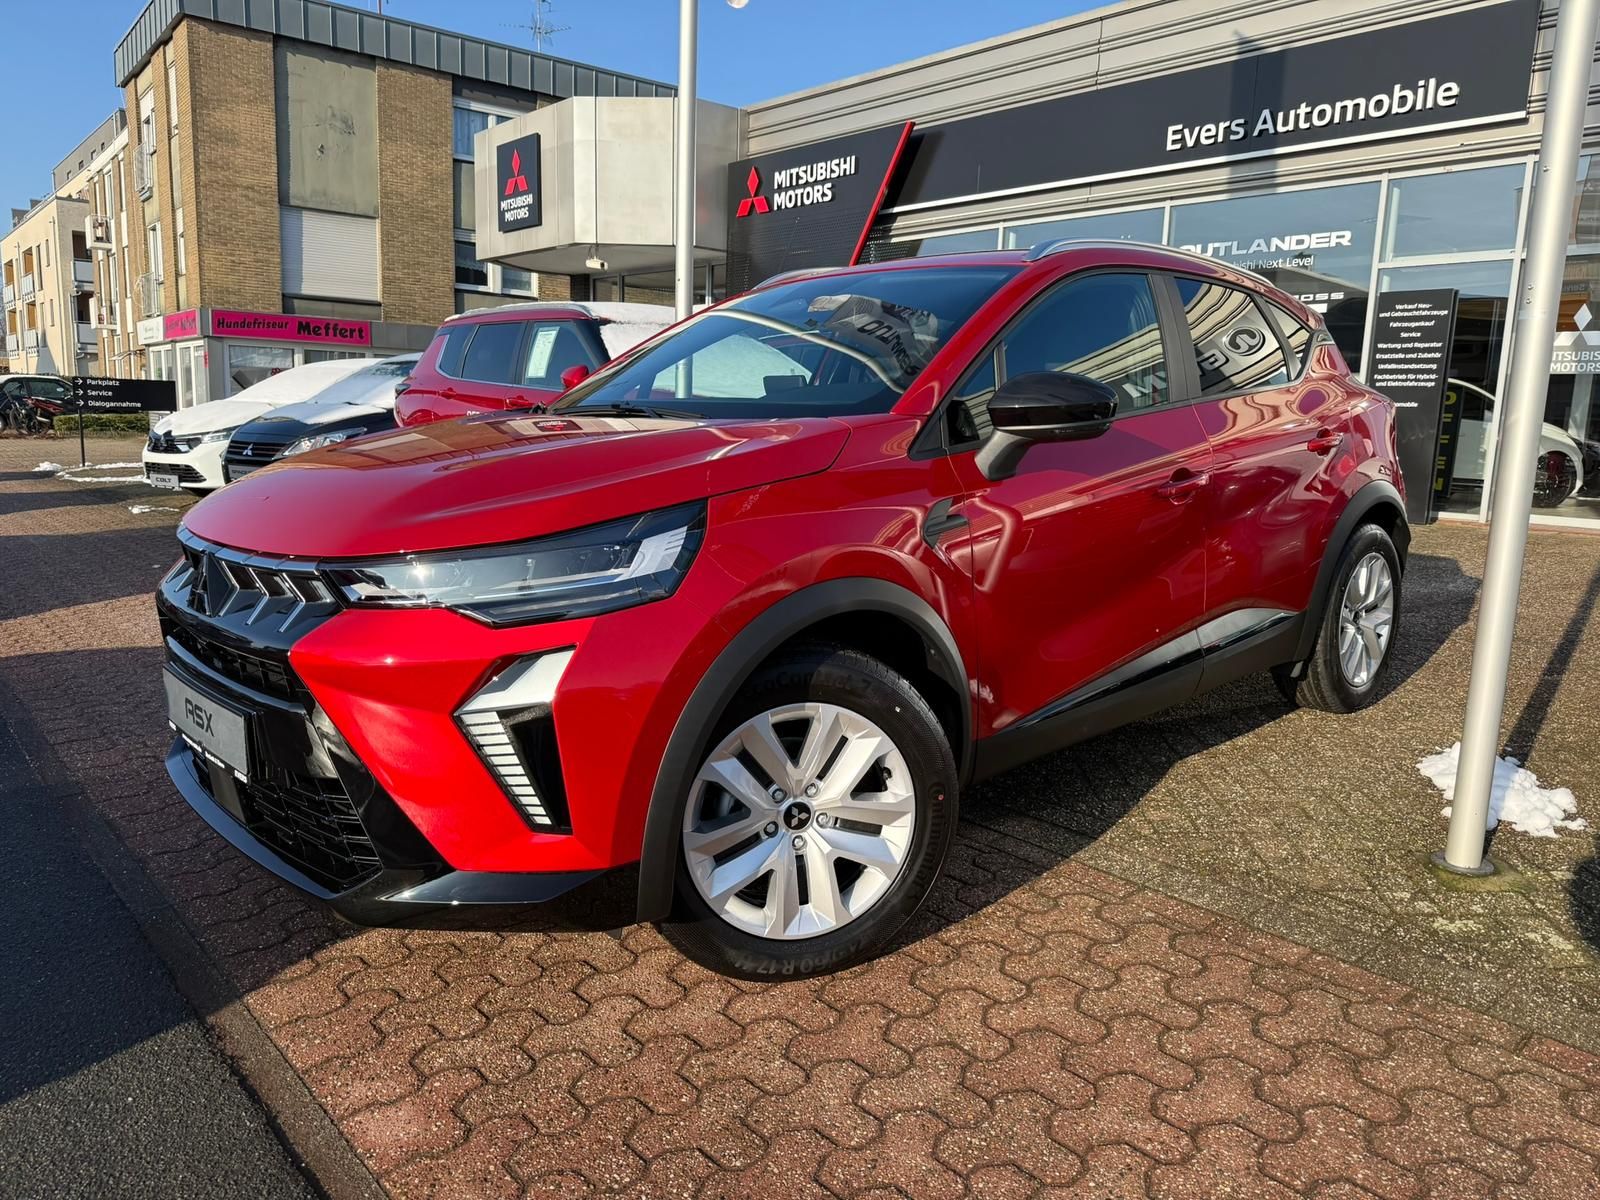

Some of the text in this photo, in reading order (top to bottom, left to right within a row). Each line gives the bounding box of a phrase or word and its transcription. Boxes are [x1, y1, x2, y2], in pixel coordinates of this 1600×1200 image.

[1166, 78, 1459, 151] Evers Automobile
[774, 155, 856, 190] MITSUBISHI
[500, 193, 534, 211] MITSUBISHI
[774, 182, 832, 211] MOTORS
[504, 207, 529, 222] MOTORS
[1258, 259, 1283, 269] Next
[1286, 255, 1314, 267] Level
[216, 317, 289, 330] Hundefriseur
[297, 320, 364, 340] Meffert
[1389, 320, 1435, 328] Fahrzeugankauf
[86, 378, 120, 387] Parkplatz
[87, 389, 112, 397] Service
[88, 400, 142, 408] Dialogannahme
[185, 697, 215, 737] ASX
